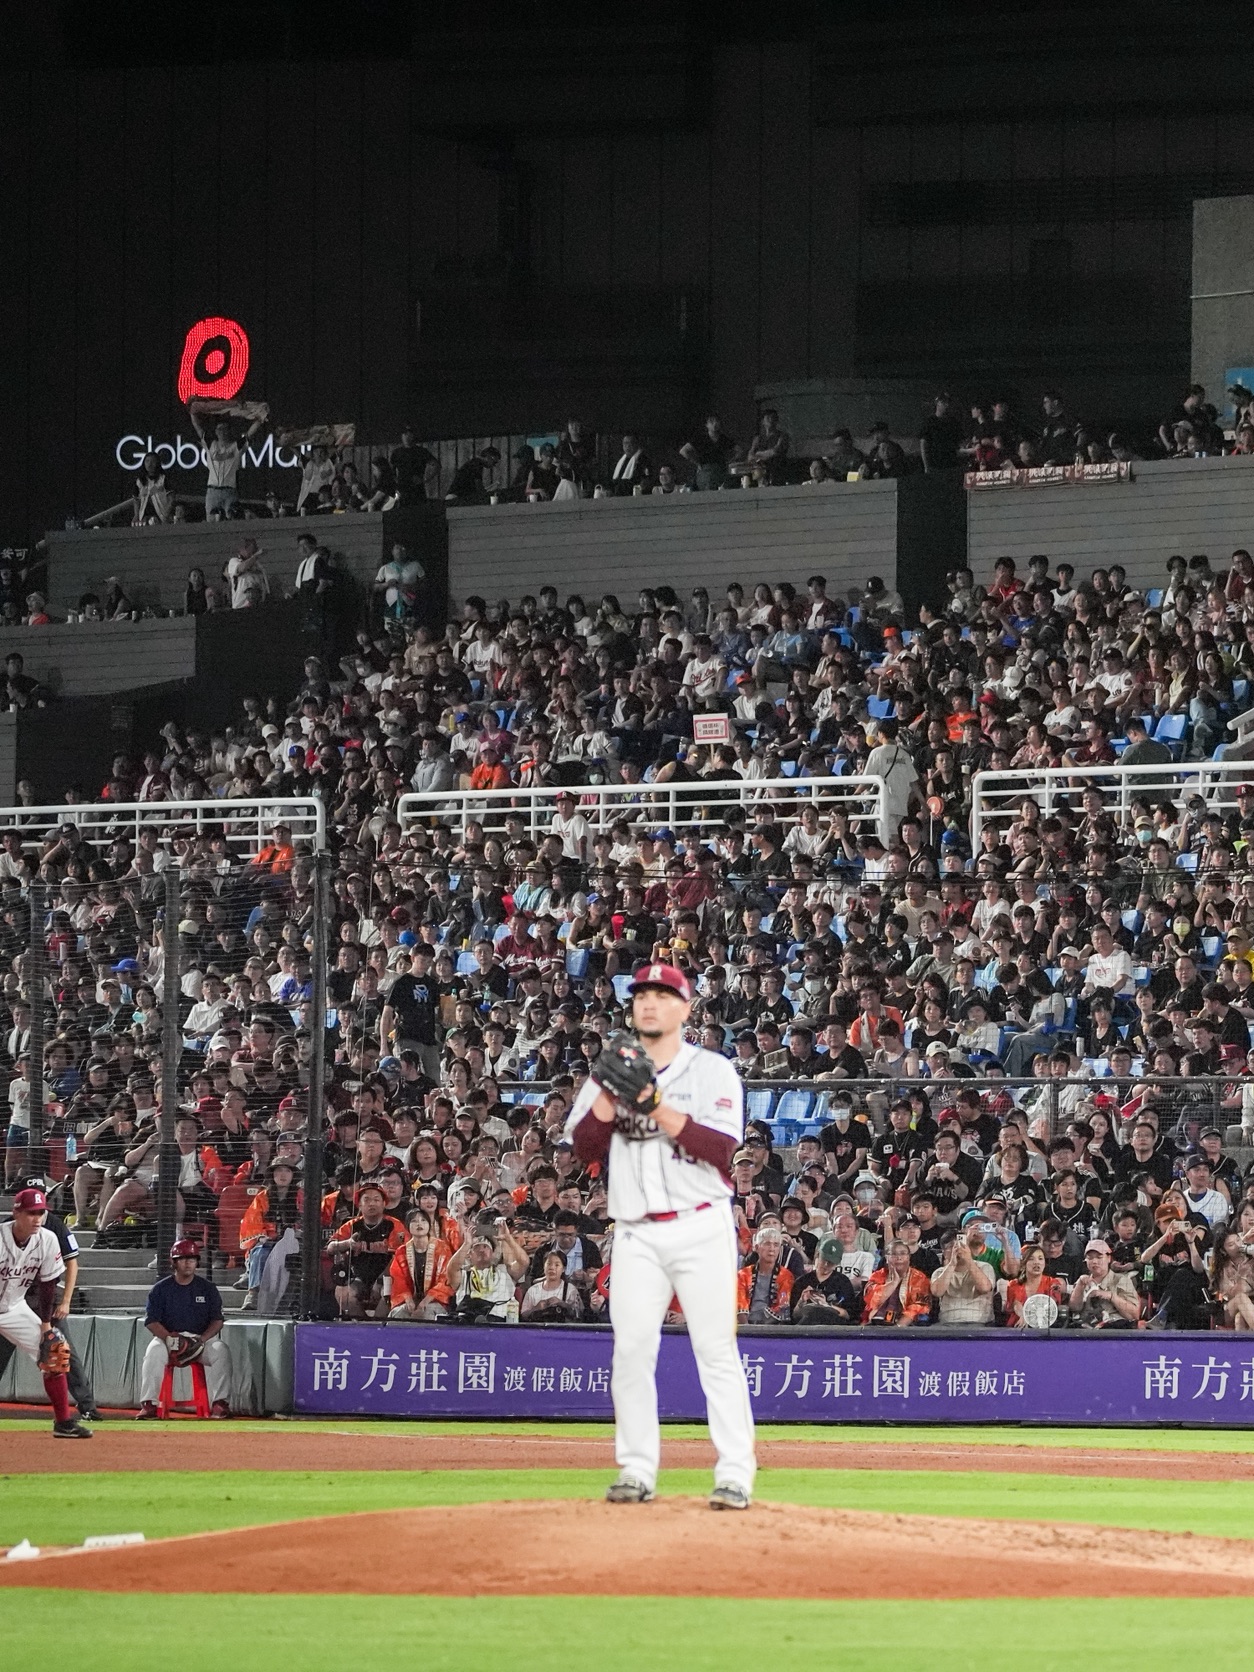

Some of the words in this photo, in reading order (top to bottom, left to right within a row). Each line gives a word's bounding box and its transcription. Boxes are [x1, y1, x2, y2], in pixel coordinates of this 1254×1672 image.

[648, 964, 661, 980] R
[26, 1178, 45, 1188] CPBL
[34, 1193, 43, 1204] R
